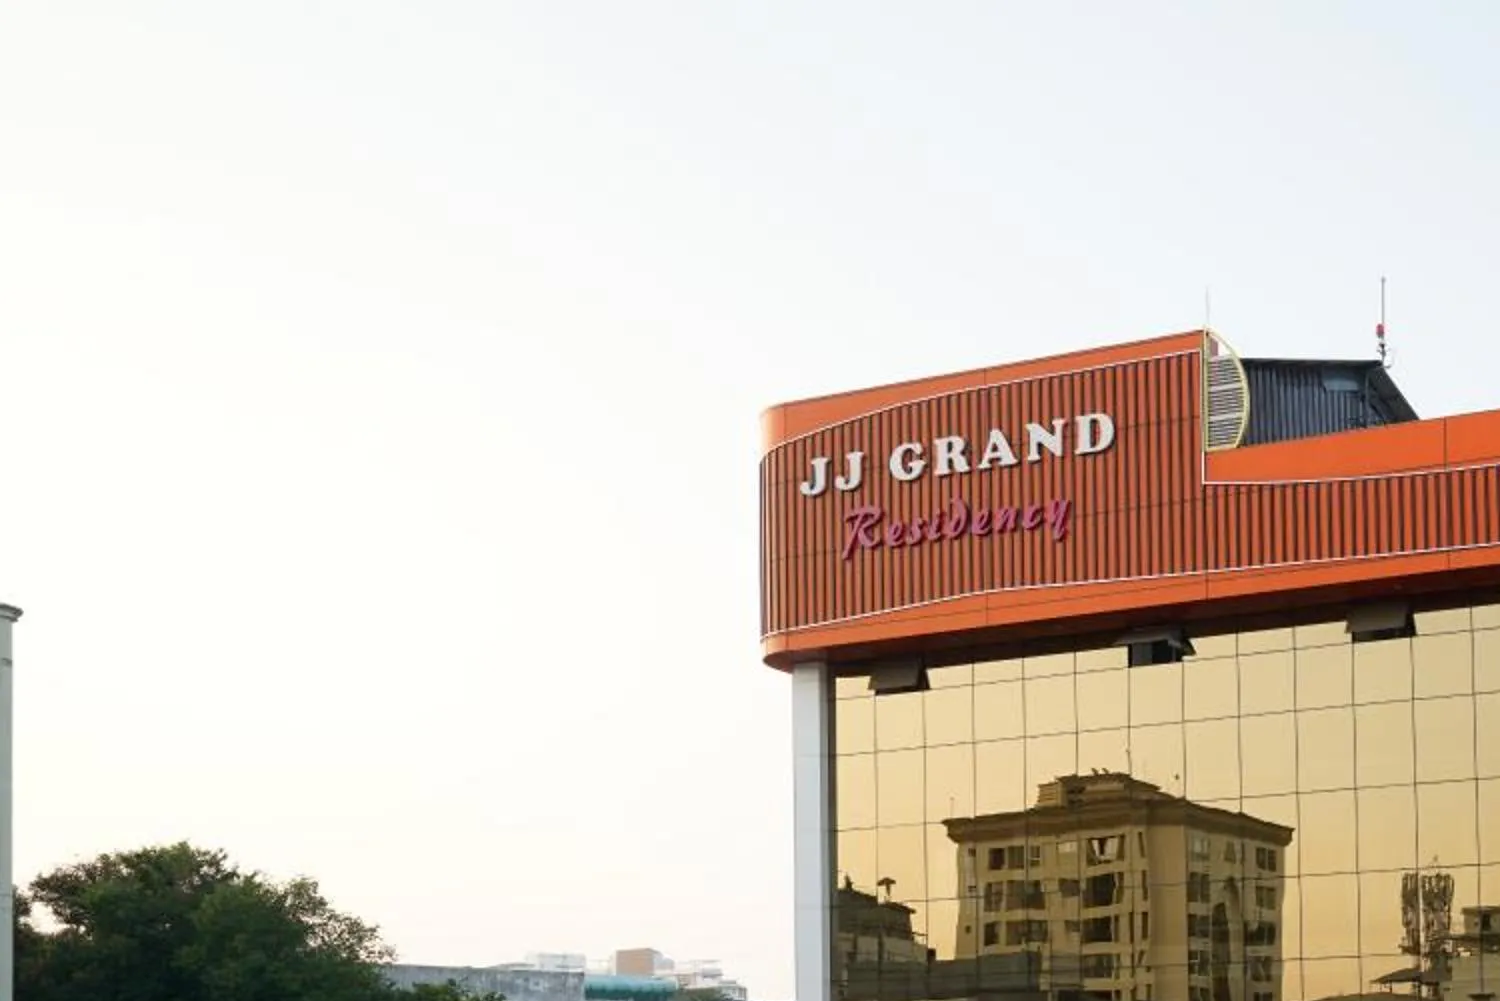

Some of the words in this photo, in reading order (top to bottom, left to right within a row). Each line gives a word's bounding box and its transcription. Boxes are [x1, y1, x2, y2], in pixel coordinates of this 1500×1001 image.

[799, 450, 866, 498] JJ
[888, 411, 1117, 483] GRAND
[841, 497, 1075, 562] Residency
